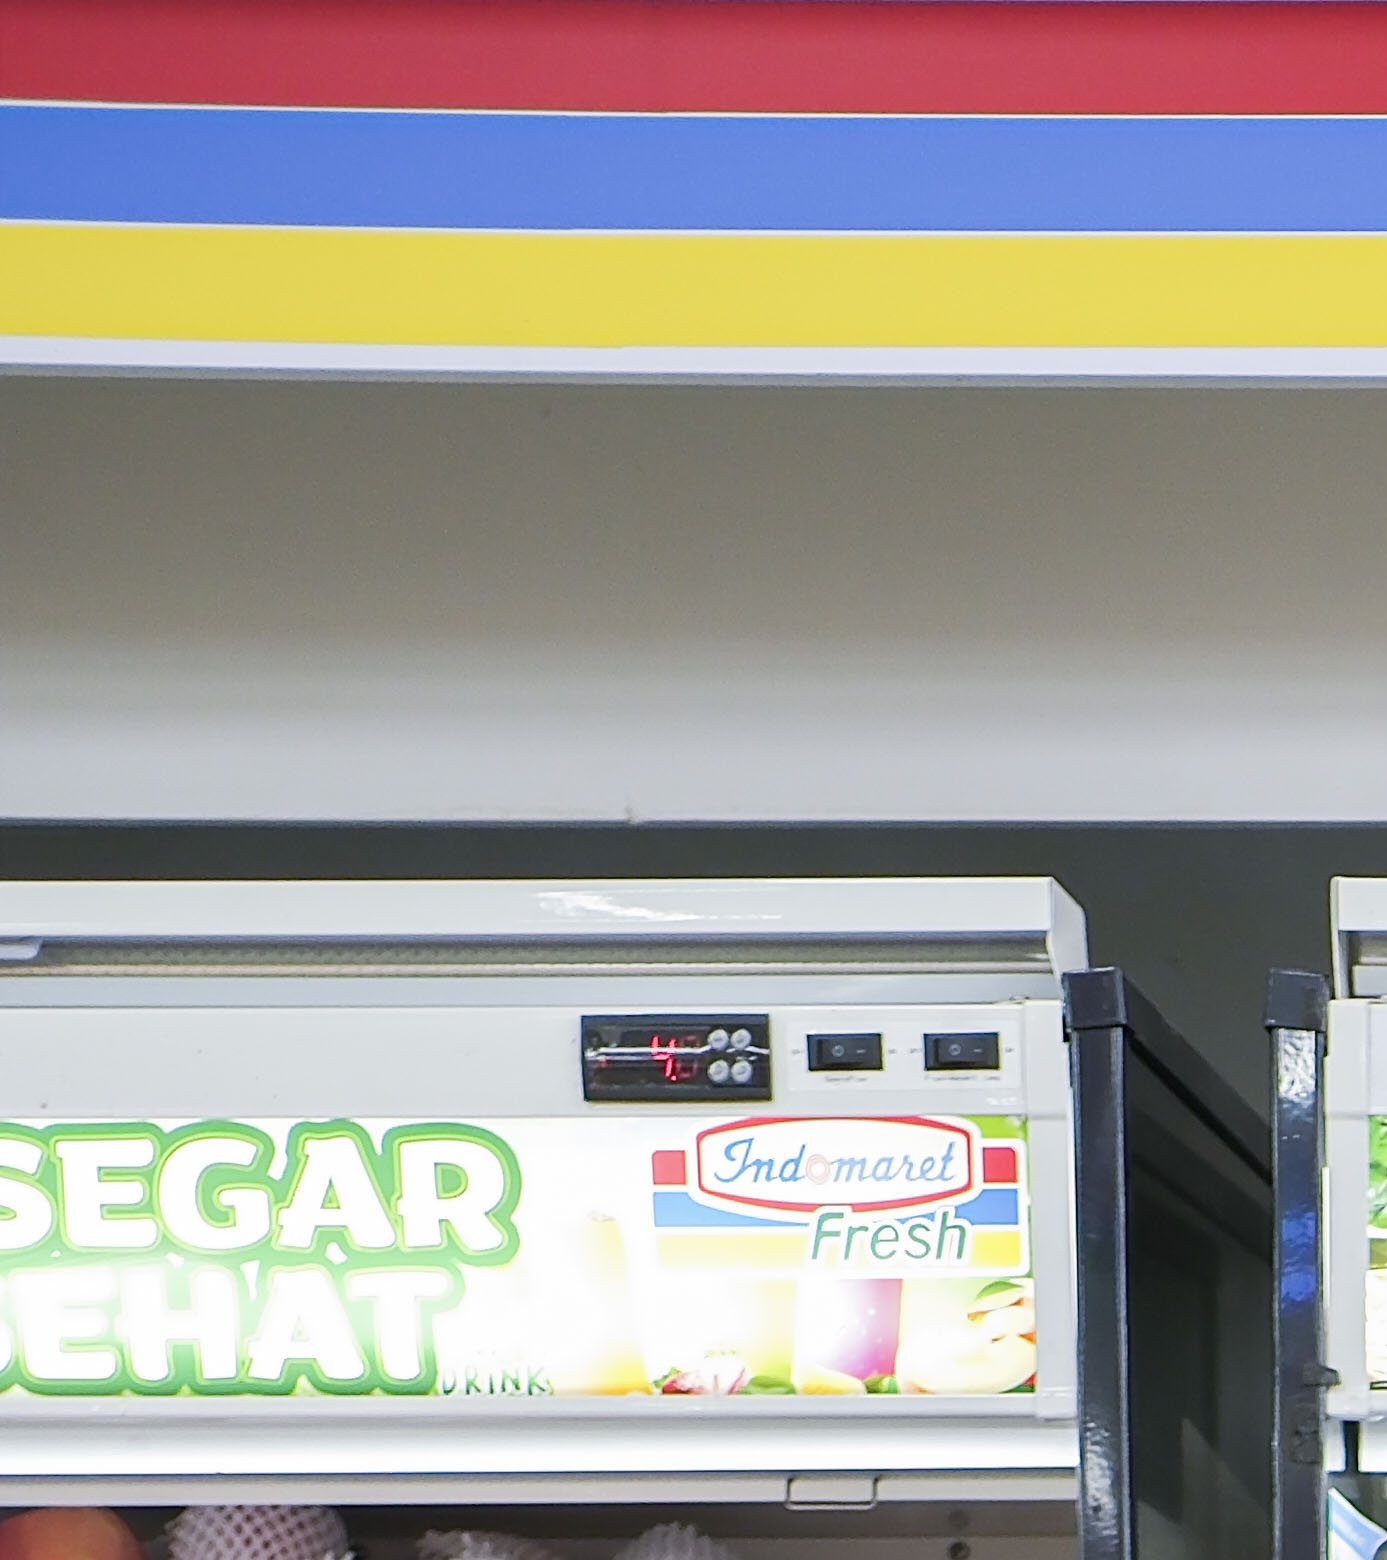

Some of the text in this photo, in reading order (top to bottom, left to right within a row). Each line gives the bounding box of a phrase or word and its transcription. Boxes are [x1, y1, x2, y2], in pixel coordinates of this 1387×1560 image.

[712, 1137, 957, 1184] Indomaret
[811, 1208, 967, 1261] Fresh
[0, 1268, 444, 1385] EHAT
